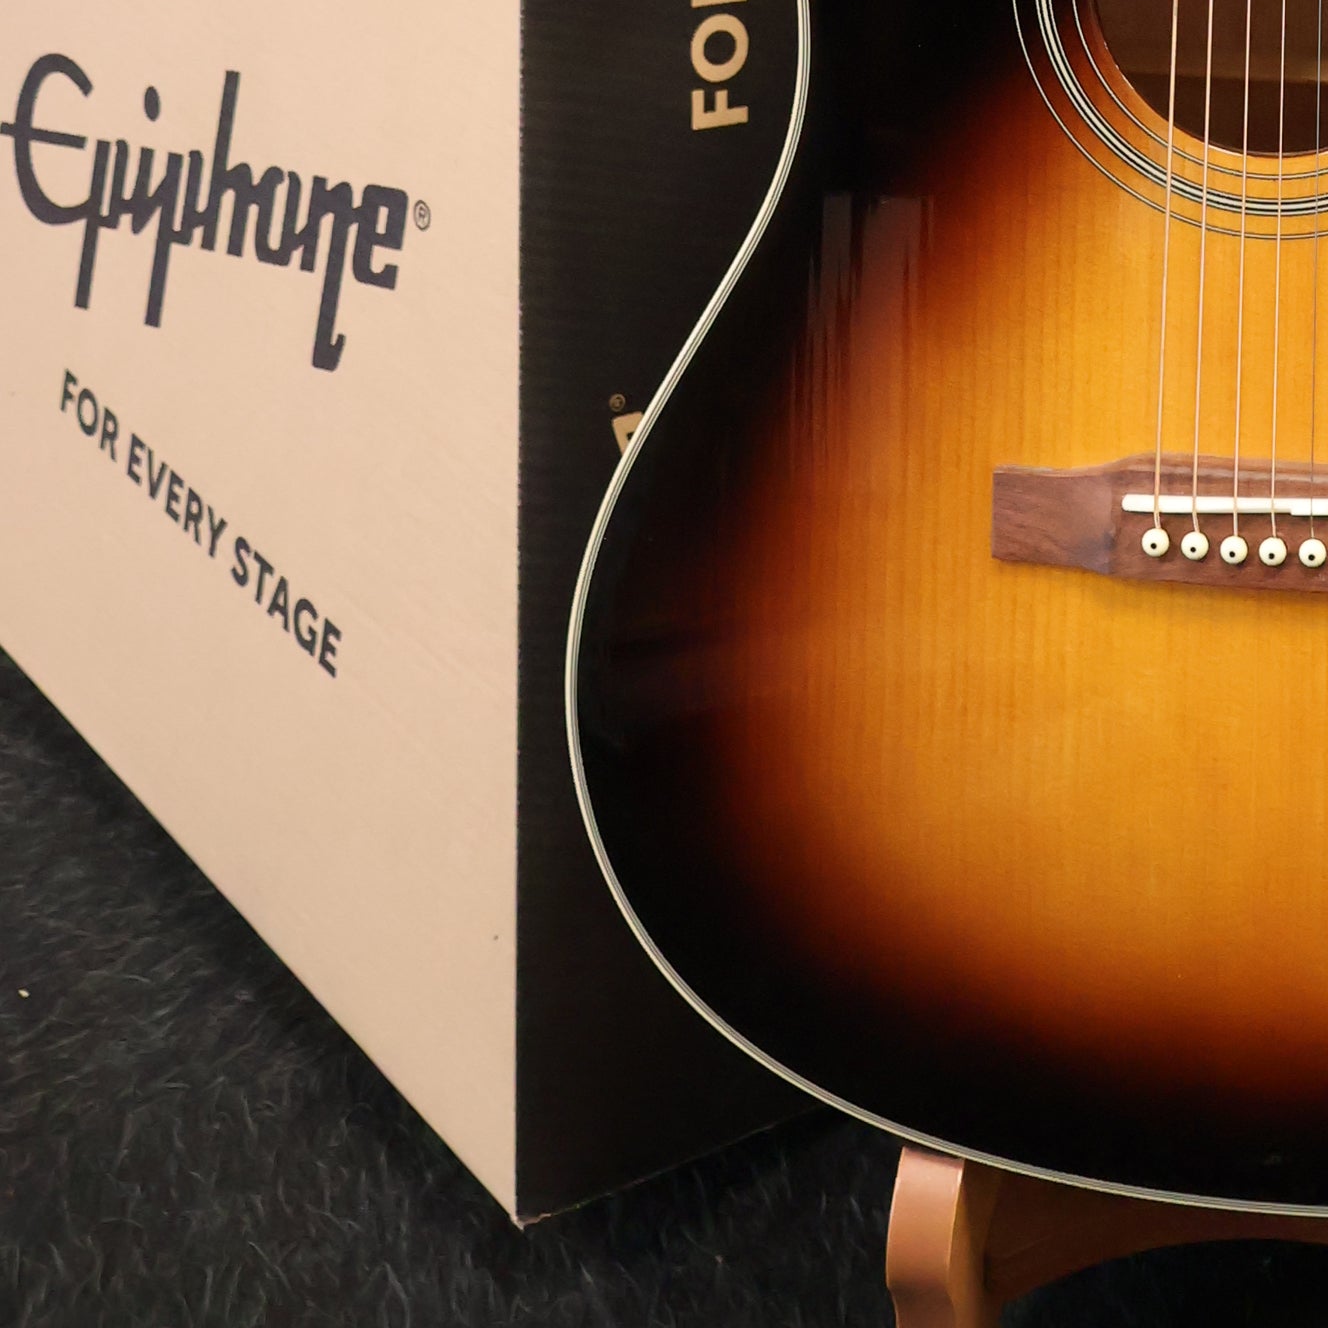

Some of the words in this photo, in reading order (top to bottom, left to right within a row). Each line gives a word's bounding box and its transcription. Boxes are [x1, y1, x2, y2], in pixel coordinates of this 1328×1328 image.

[60, 368, 120, 462] FOR
[126, 432, 228, 559] EVERY
[230, 536, 342, 679] STAGE
